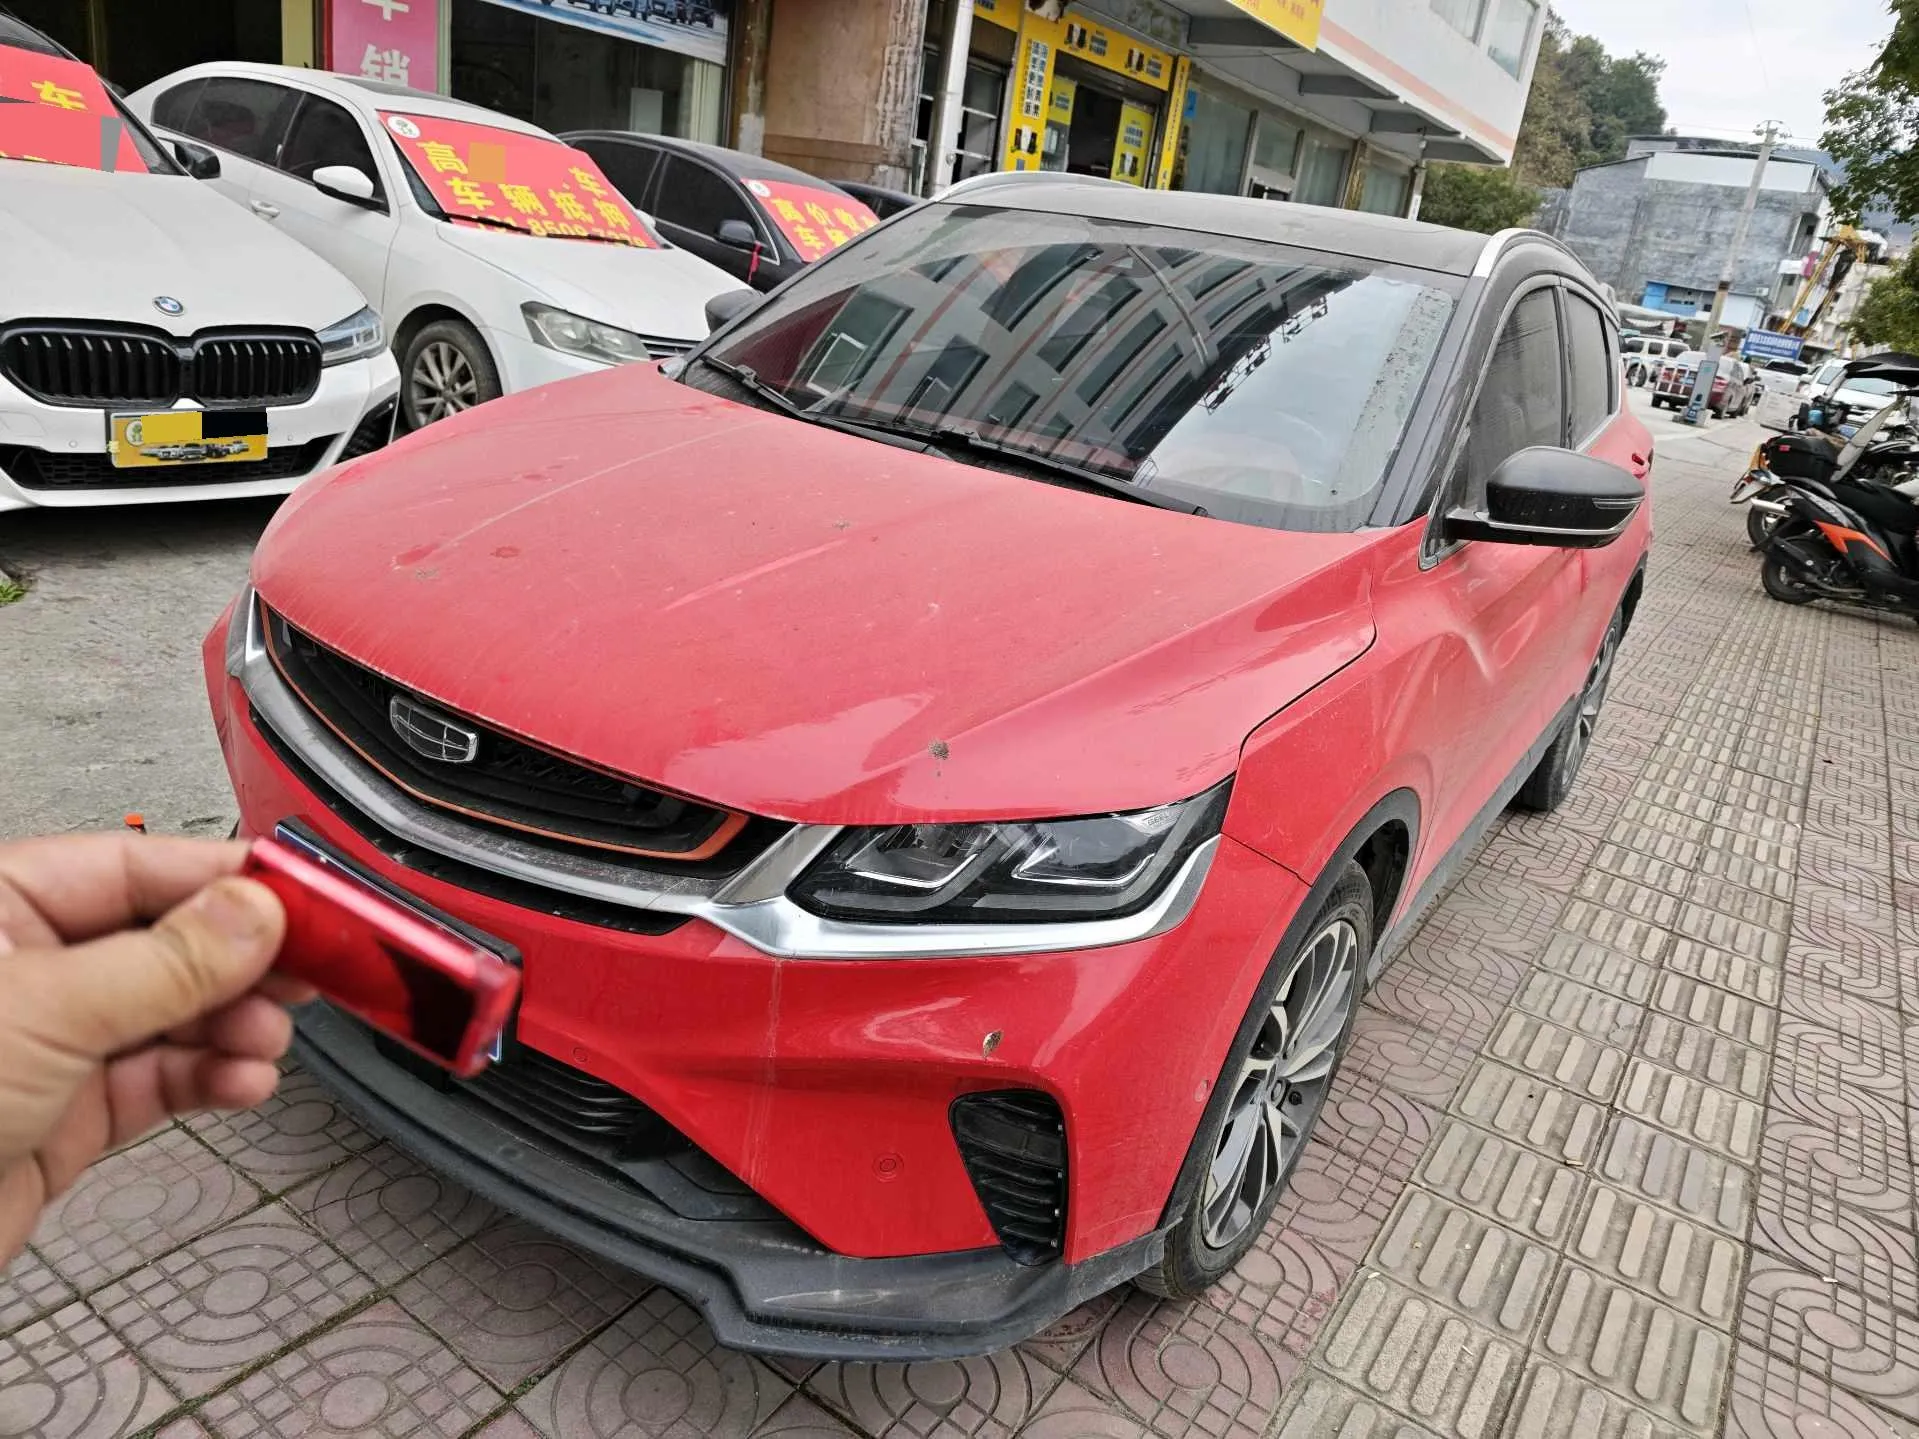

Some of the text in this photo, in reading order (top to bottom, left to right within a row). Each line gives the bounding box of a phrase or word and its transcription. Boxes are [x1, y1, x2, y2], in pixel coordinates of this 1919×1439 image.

[30, 80, 88, 112] 车
[444, 177, 632, 232] 车辆抵押
